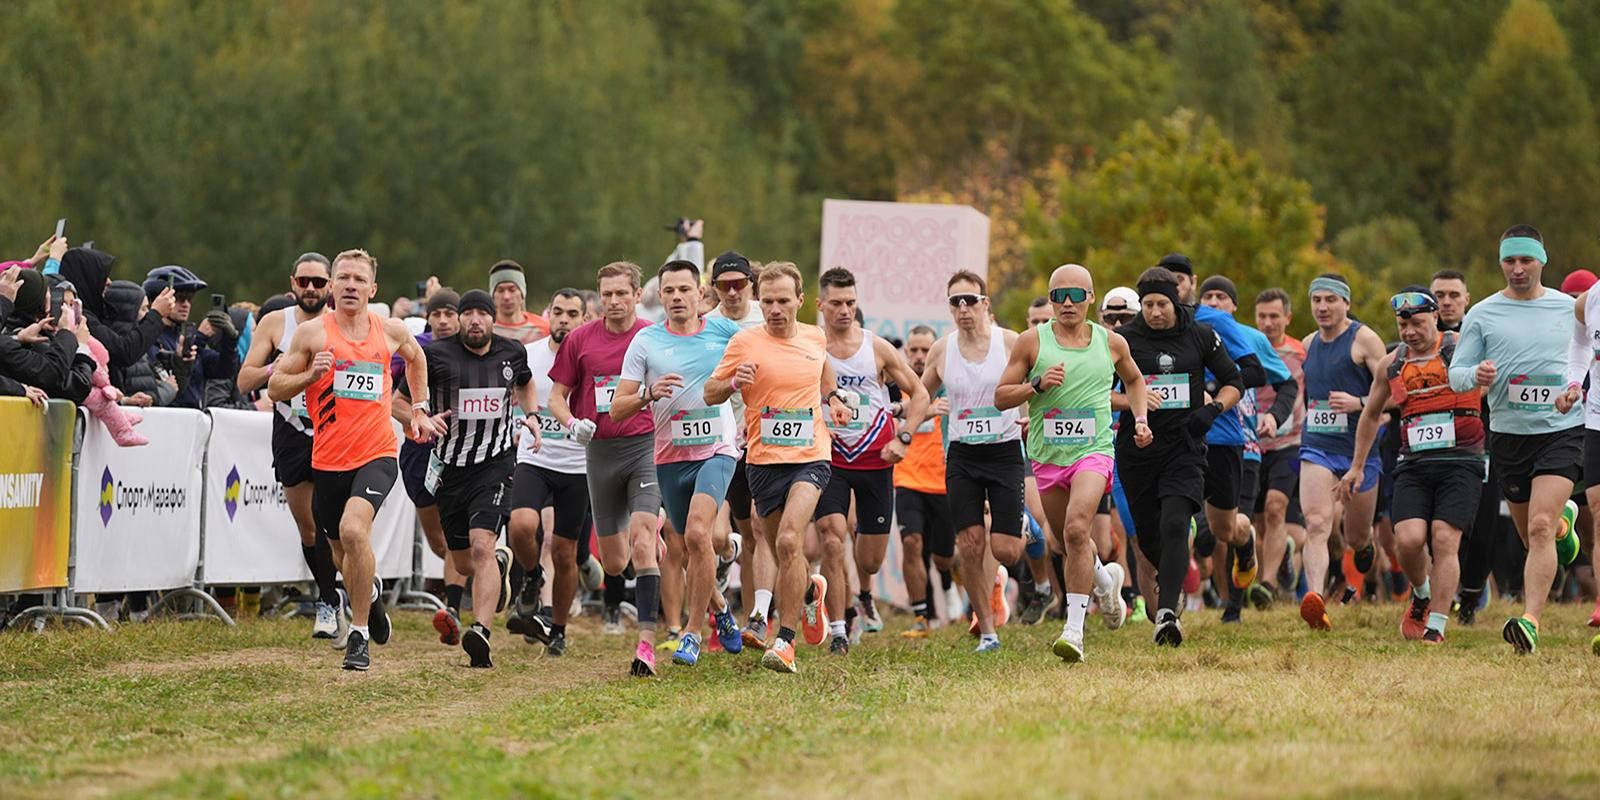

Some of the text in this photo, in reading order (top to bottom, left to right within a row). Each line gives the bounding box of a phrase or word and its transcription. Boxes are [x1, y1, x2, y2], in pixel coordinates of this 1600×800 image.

[346, 374, 374, 391] 795
[838, 375, 866, 387] STY
[1152, 386, 1177, 400] 31
[1520, 388, 1550, 402] 619
[463, 395, 500, 412] mts
[1314, 412, 1337, 425] 689
[682, 420, 711, 436] 510
[772, 422, 802, 437] 687
[966, 420, 991, 433] 751
[1055, 422, 1085, 435] 594
[1417, 426, 1443, 441] 739
